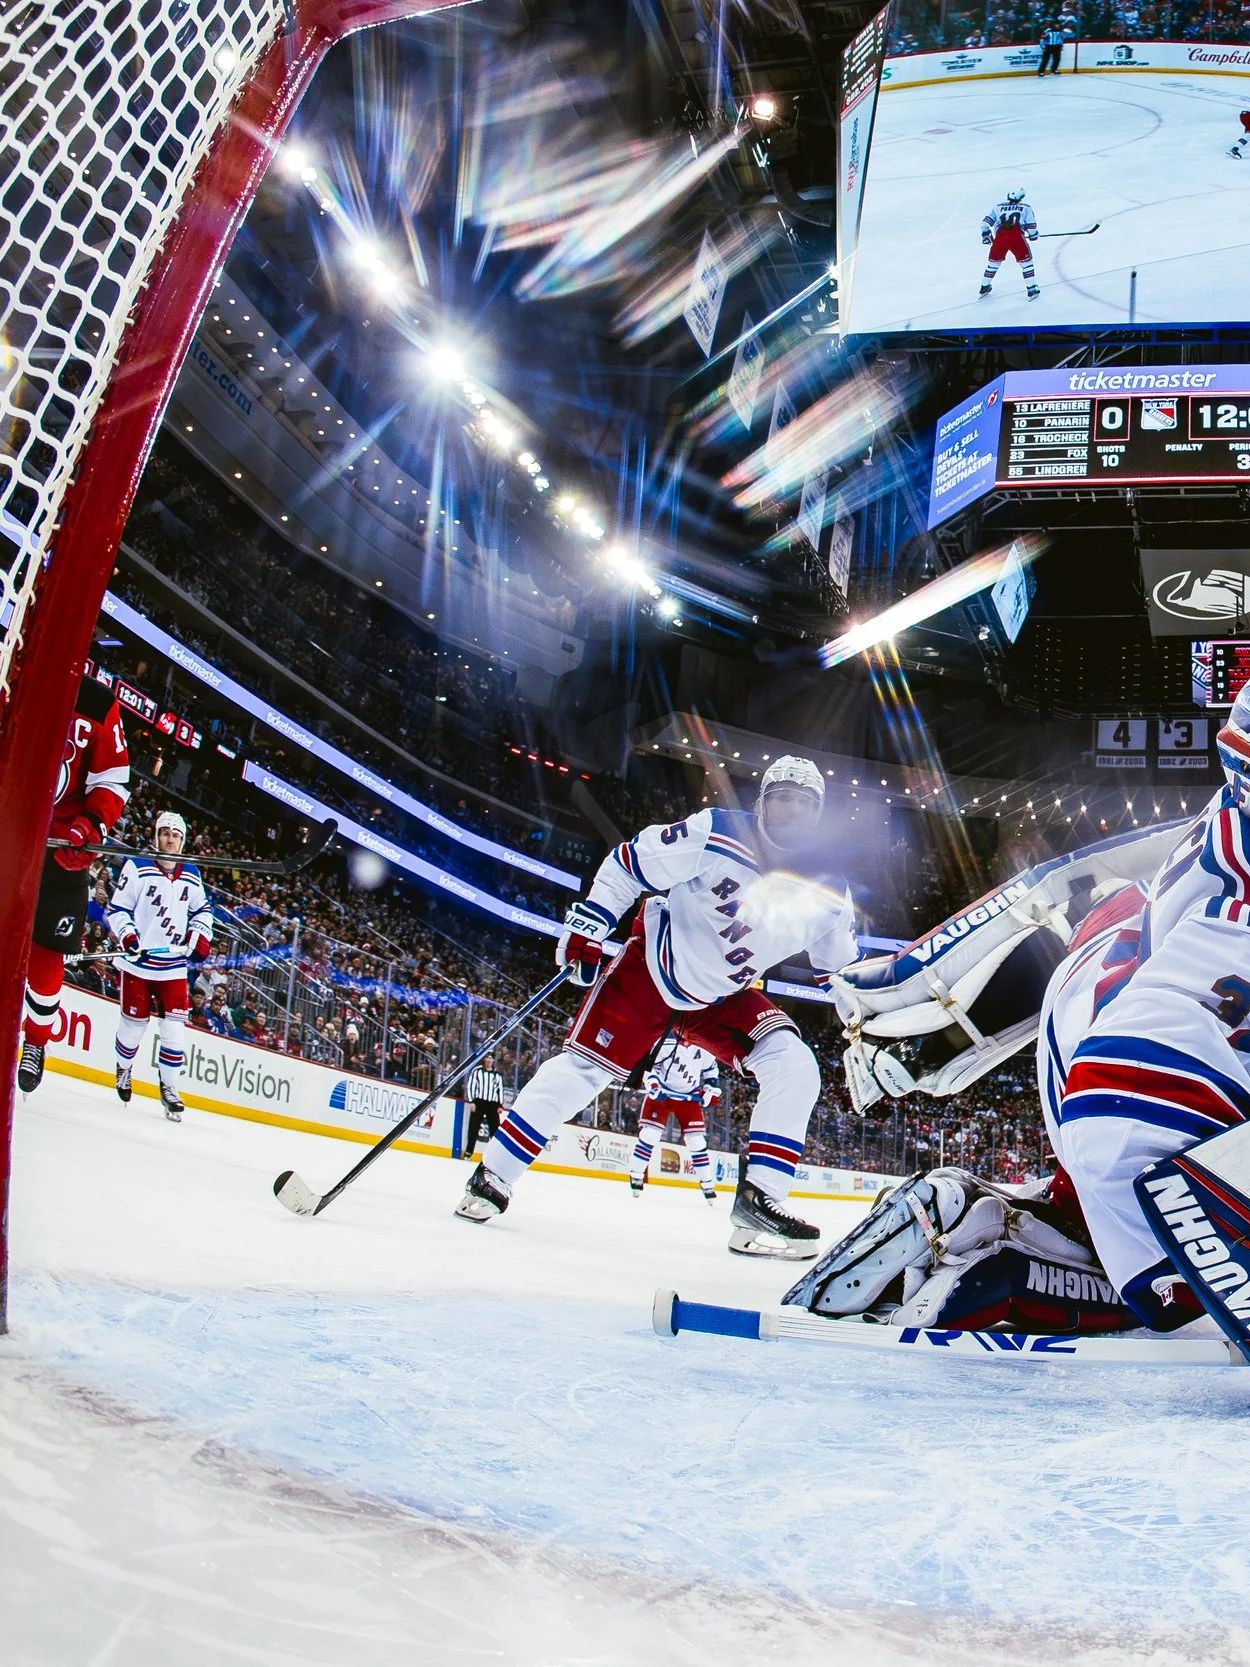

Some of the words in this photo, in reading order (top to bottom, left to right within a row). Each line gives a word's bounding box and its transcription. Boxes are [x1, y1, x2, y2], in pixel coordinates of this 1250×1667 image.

[1068, 371, 1216, 391] ticketmaster
[940, 402, 983, 438] ticketmaster
[1015, 404, 1028, 413] 13
[1101, 406, 1123, 430] 0
[1014, 419, 1027, 429] 10
[1044, 417, 1090, 428] PANARIN
[961, 430, 979, 445] SELL
[1034, 433, 1089, 443] TROCHECK
[1097, 445, 1126, 453] SHOTS
[1165, 443, 1203, 452] PENALTY
[1010, 450, 1025, 460] 23
[1067, 449, 1088, 459] FOX
[1101, 455, 1119, 467] 10
[1236, 454, 1250, 469] 3
[935, 452, 993, 498] TICKETMASTER
[936, 460, 967, 486] TICKETS
[967, 450, 979, 464] AT
[1035, 464, 1087, 475] LINDGREN
[168, 644, 223, 687] ticketmaster
[119, 686, 143, 709] 12:01
[74, 717, 92, 749] C
[266, 710, 313, 749] ticketmaster
[1113, 721, 1131, 748] 4
[1174, 721, 1193, 749] 3
[353, 766, 393, 798] ticketmaster
[261, 775, 315, 815] ticketmaster
[358, 831, 402, 863] ticketmaster
[503, 851, 546, 876] ticketmaster
[179, 886, 189, 901] A
[439, 874, 477, 901] ticketmaster
[146, 885, 182, 946] RANGER
[511, 910, 557, 934] ticketmaster
[909, 880, 1031, 963] VAUGHN
[786, 986, 835, 1002] ticketmast
